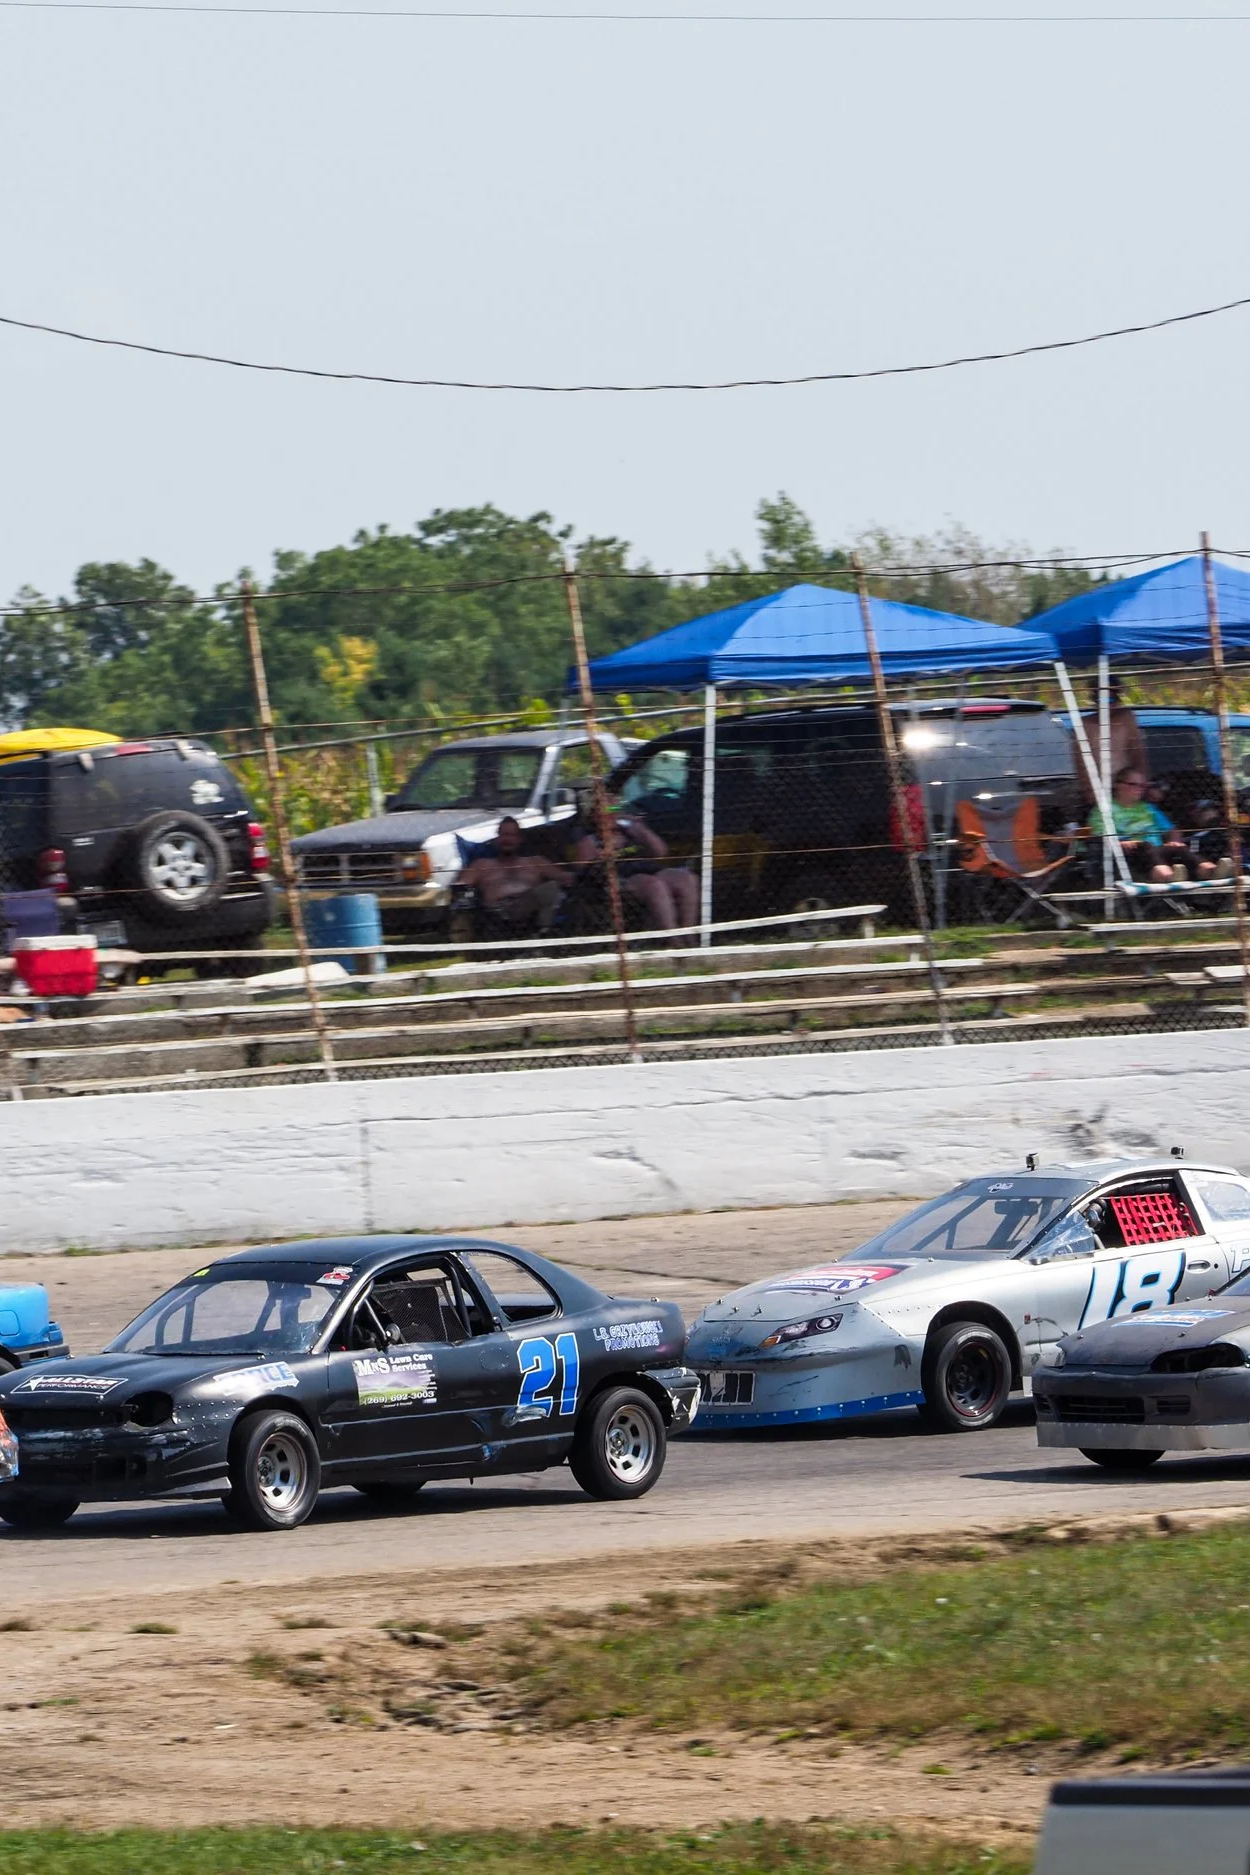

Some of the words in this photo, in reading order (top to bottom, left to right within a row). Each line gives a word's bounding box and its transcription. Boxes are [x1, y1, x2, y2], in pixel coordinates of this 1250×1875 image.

[1078, 1249, 1187, 1331] 18
[605, 1333, 660, 1351] PROMOTIONS
[389, 1355, 412, 1364] Lawn
[412, 1353, 433, 1361] Care
[392, 1362, 427, 1372] Services
[516, 1332, 580, 1418] 21
[359, 1395, 388, 1406] (269)
[390, 1390, 435, 1402] 692-3003
